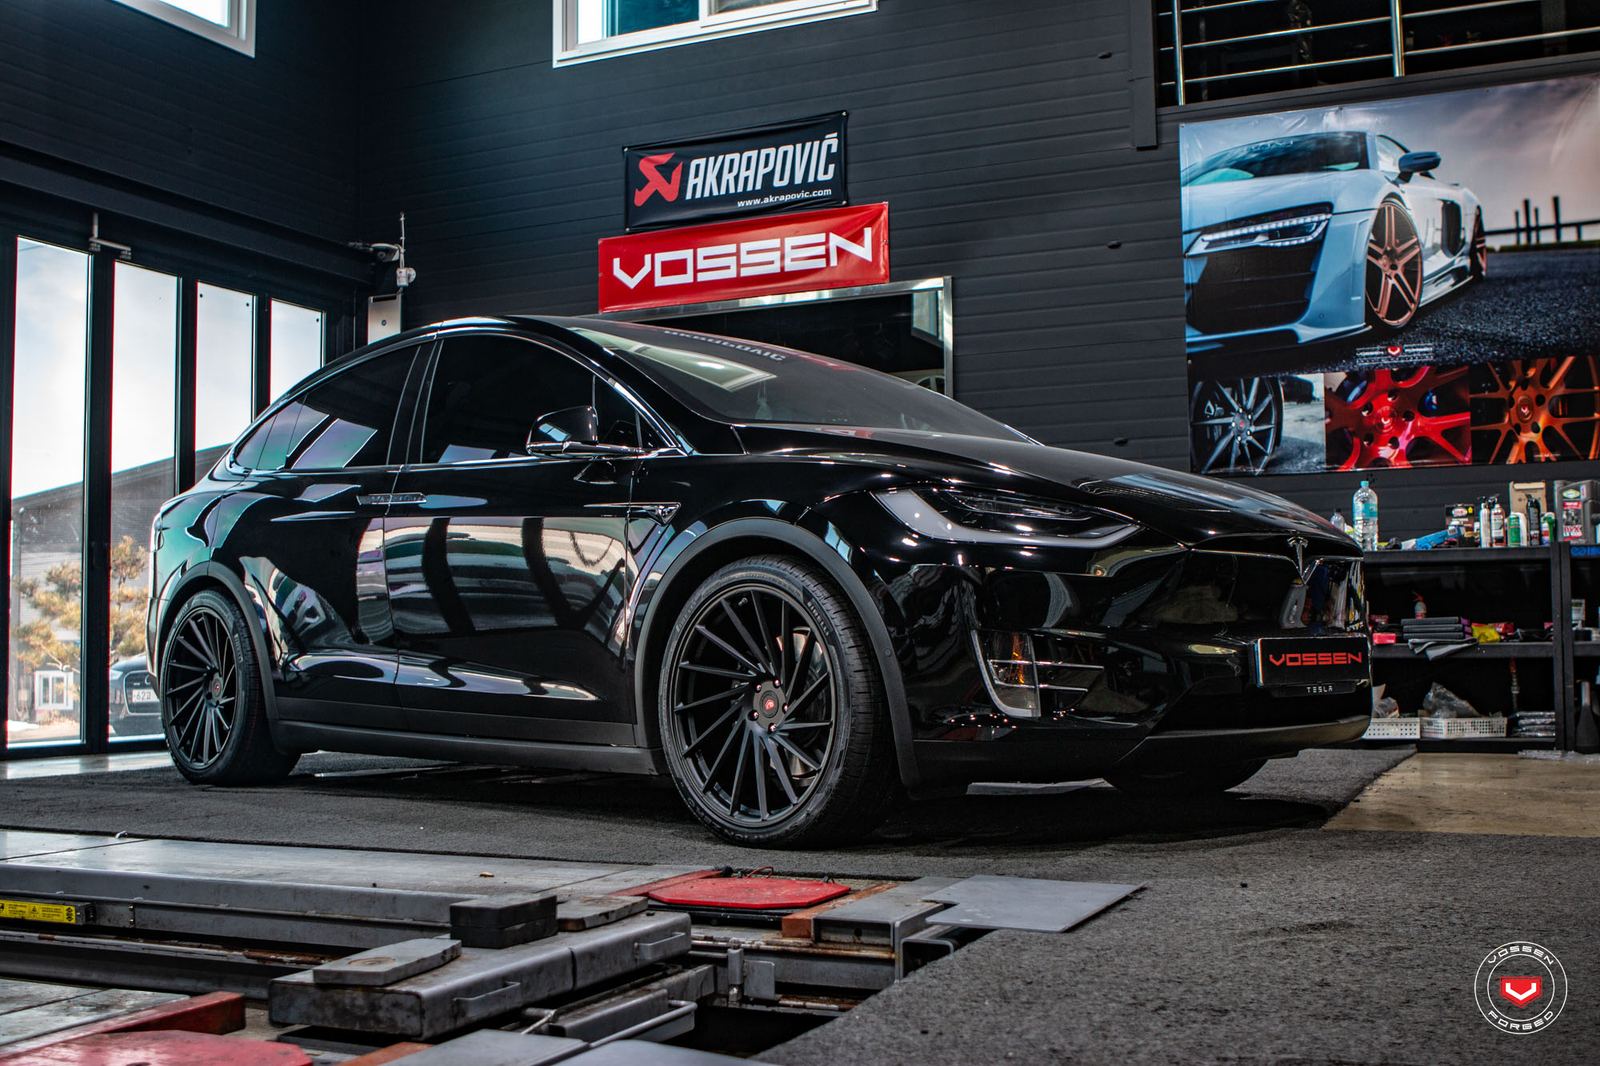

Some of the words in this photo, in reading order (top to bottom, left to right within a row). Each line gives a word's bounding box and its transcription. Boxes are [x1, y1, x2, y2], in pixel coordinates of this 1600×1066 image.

[737, 188, 832, 207] www.akrapovic.com
[613, 227, 873, 289] VOSSEN
[1269, 652, 1362, 666] VOSSEN
[1306, 685, 1333, 693] TESLA
